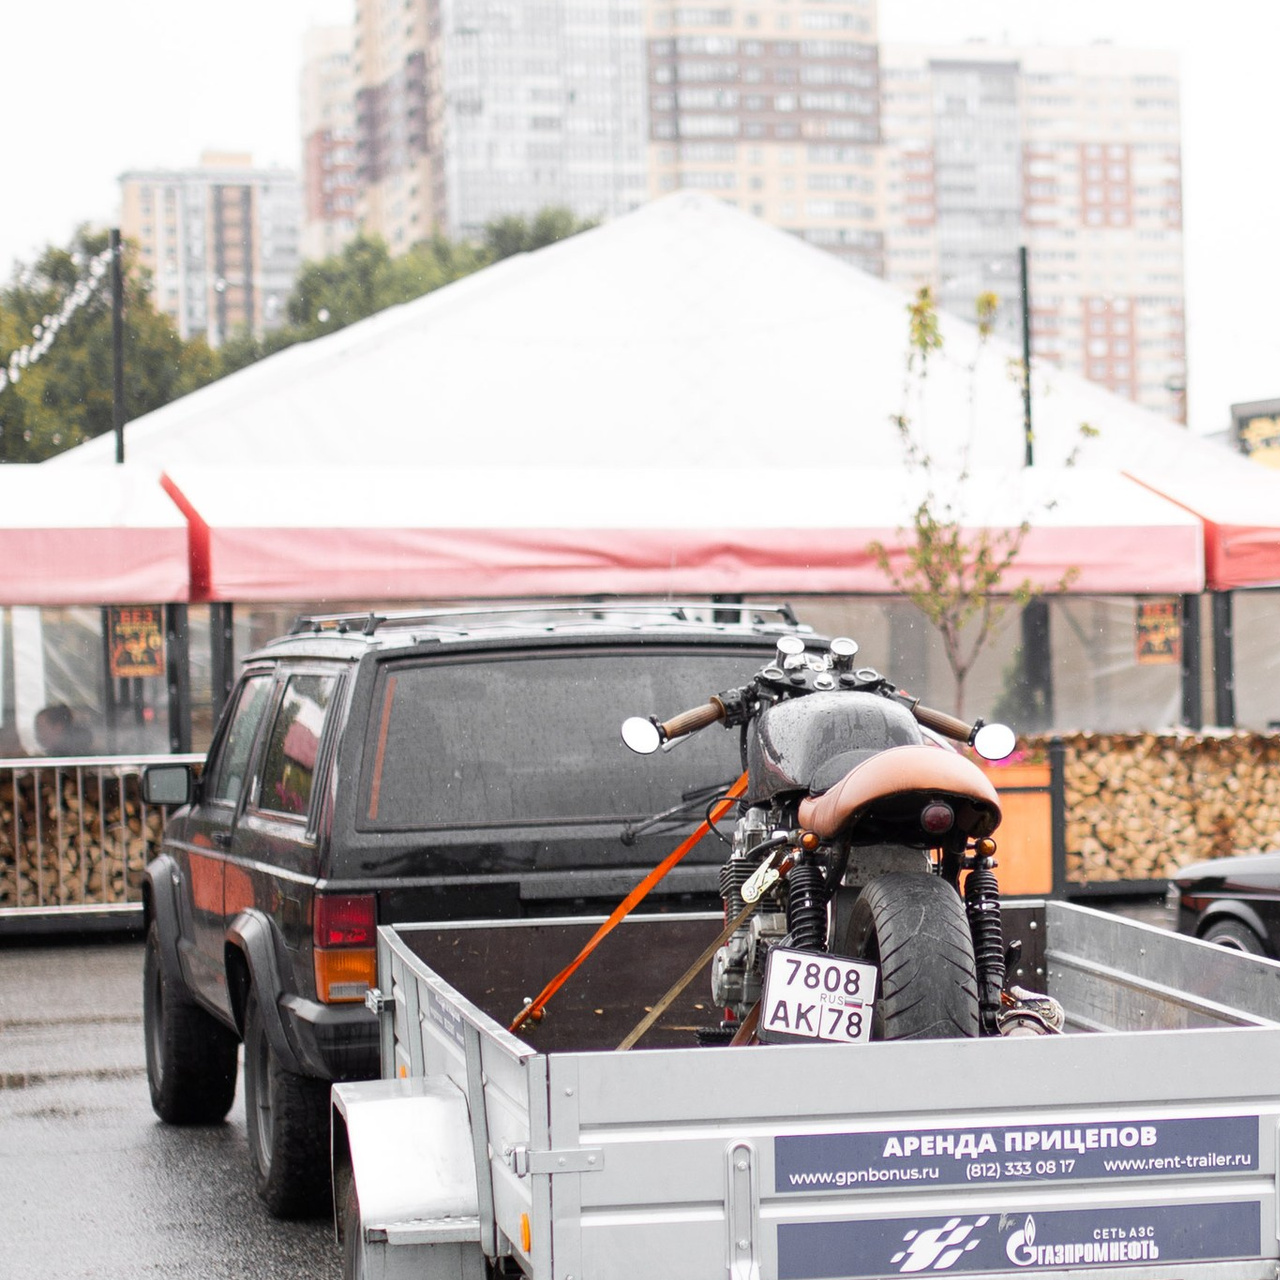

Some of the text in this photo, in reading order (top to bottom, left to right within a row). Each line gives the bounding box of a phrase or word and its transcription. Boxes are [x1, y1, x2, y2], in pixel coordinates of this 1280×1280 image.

[786, 958, 860, 996] 7808
[820, 992, 845, 1006] RUS
[769, 999, 863, 1039] АК 78
[882, 1125, 1158, 1160] АРЕНДА ПРИЦЕПОВ
[965, 1159, 1076, 1180] (812) 333 08 17
[1103, 1152, 1252, 1172] www.rent-trailer.ru
[788, 1165, 940, 1186] www.gpnbonus.ru
[1092, 1226, 1155, 1240] СЕТЬ АЗС
[1037, 1240, 1160, 1266] ГАЗПРОМНЕФТЬ
